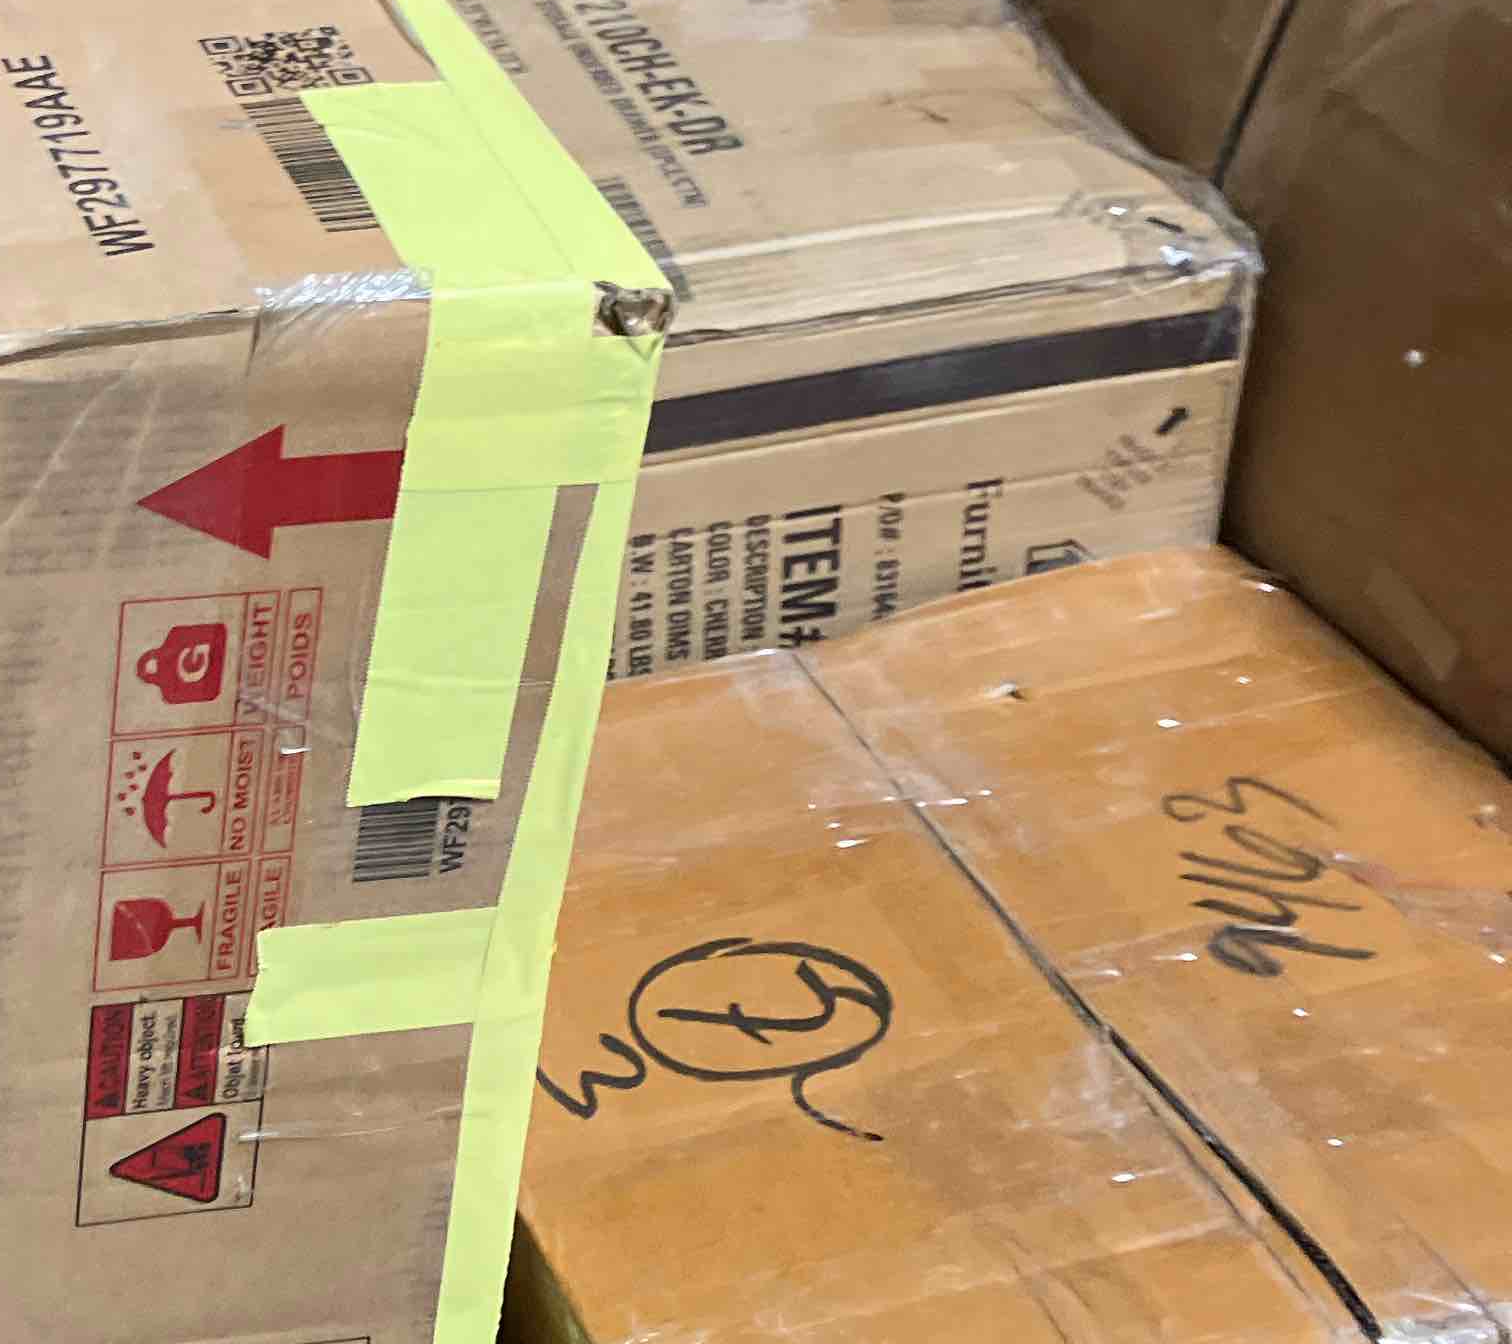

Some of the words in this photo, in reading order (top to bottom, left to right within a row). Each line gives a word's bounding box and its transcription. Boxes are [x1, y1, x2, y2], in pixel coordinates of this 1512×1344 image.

[2, 54, 156, 257] WF297719AAE
[741, 514, 771, 640] DESCRIPTION
[242, 602, 273, 715] WEIGHT
[287, 612, 312, 700] POIDS
[233, 740, 256, 810] MOIST
[230, 817, 248, 851] NO
[438, 798, 471, 874] WF29
[1161, 775, 1378, 979] 9463
[216, 868, 243, 971] FRAGILE
[259, 865, 283, 932] AGILE
[134, 1064, 156, 1109] Heavy
